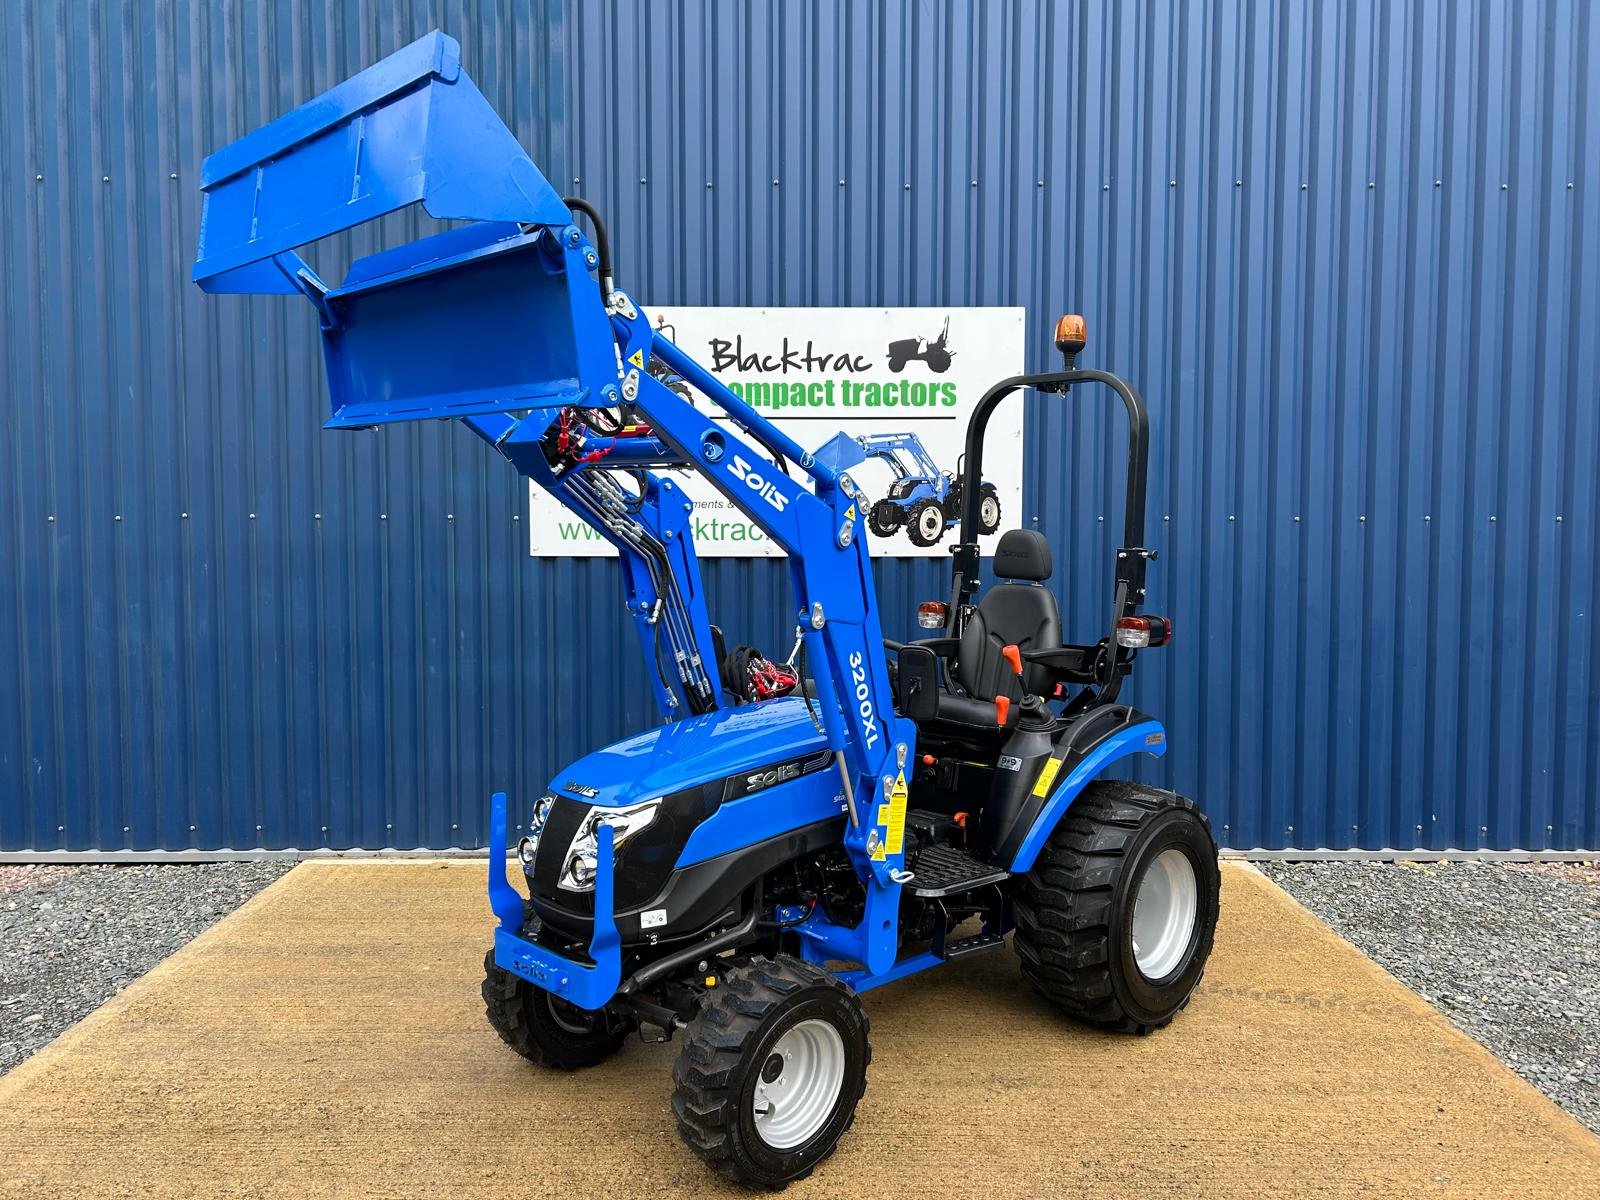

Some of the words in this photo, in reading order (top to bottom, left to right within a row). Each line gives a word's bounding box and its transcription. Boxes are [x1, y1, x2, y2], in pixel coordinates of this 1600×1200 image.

[707, 334, 873, 374] Blacktrac
[711, 379, 836, 410] ompact
[841, 379, 957, 407] tractors
[849, 651, 879, 750] 3200XL
